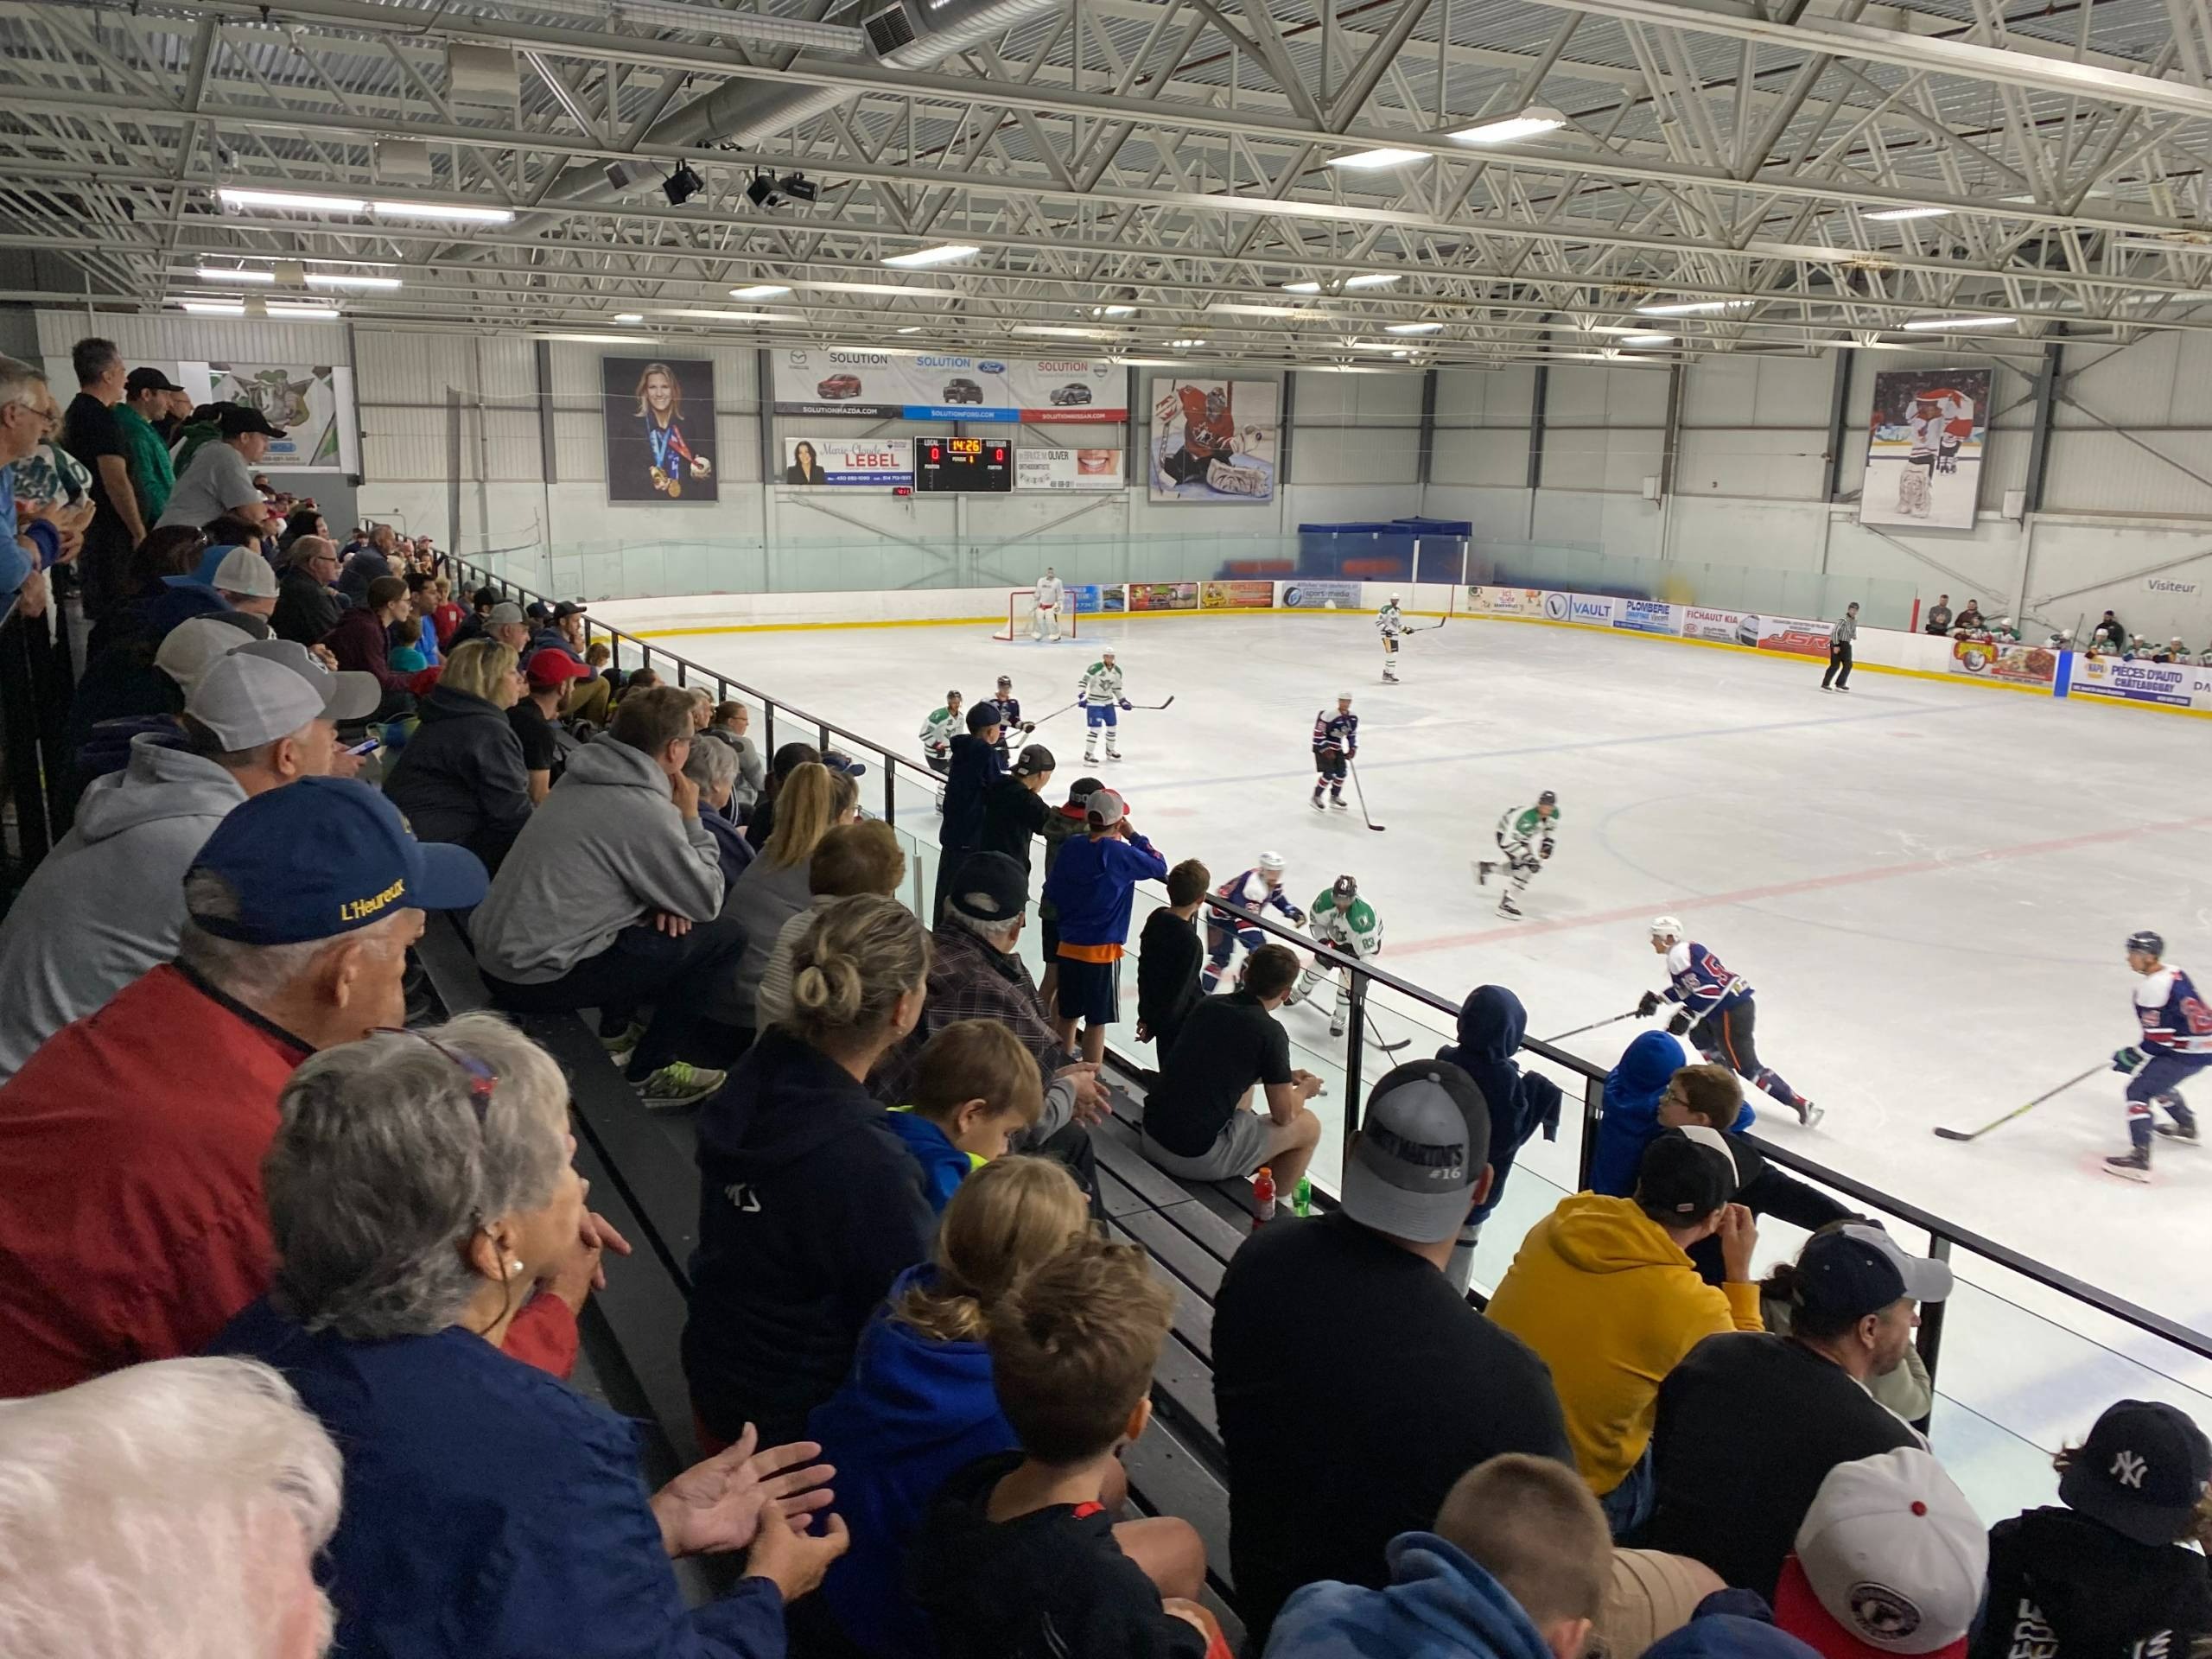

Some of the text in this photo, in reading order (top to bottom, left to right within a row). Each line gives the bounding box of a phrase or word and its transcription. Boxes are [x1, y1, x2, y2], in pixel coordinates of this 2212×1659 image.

[830, 353, 888, 365] SOLUTION
[917, 356, 970, 367] SOLUTION
[1038, 361, 1088, 372] SOLUTION
[803, 406, 878, 415] SOLUTIONMAZDA.COM
[953, 440, 980, 451] 14:26
[845, 454, 900, 467] LEBEL
[931, 448, 939, 460] 0
[996, 448, 1004, 461] 0
[1048, 451, 1069, 460] OLIVER
[2148, 580, 2196, 593] Visiteur
[1573, 602, 1611, 617] VAULT
[1626, 601, 1670, 614] PLOMBERIE
[1687, 610, 1738, 624] FICHAULT KIA
[1770, 630, 1831, 648] JSR
[2111, 664, 2183, 683] PIÈCES D'AUTO
[340, 879, 405, 920] L'Heureux
[1429, 1167, 1462, 1179] #16
[2109, 1450, 2148, 1489] NY
